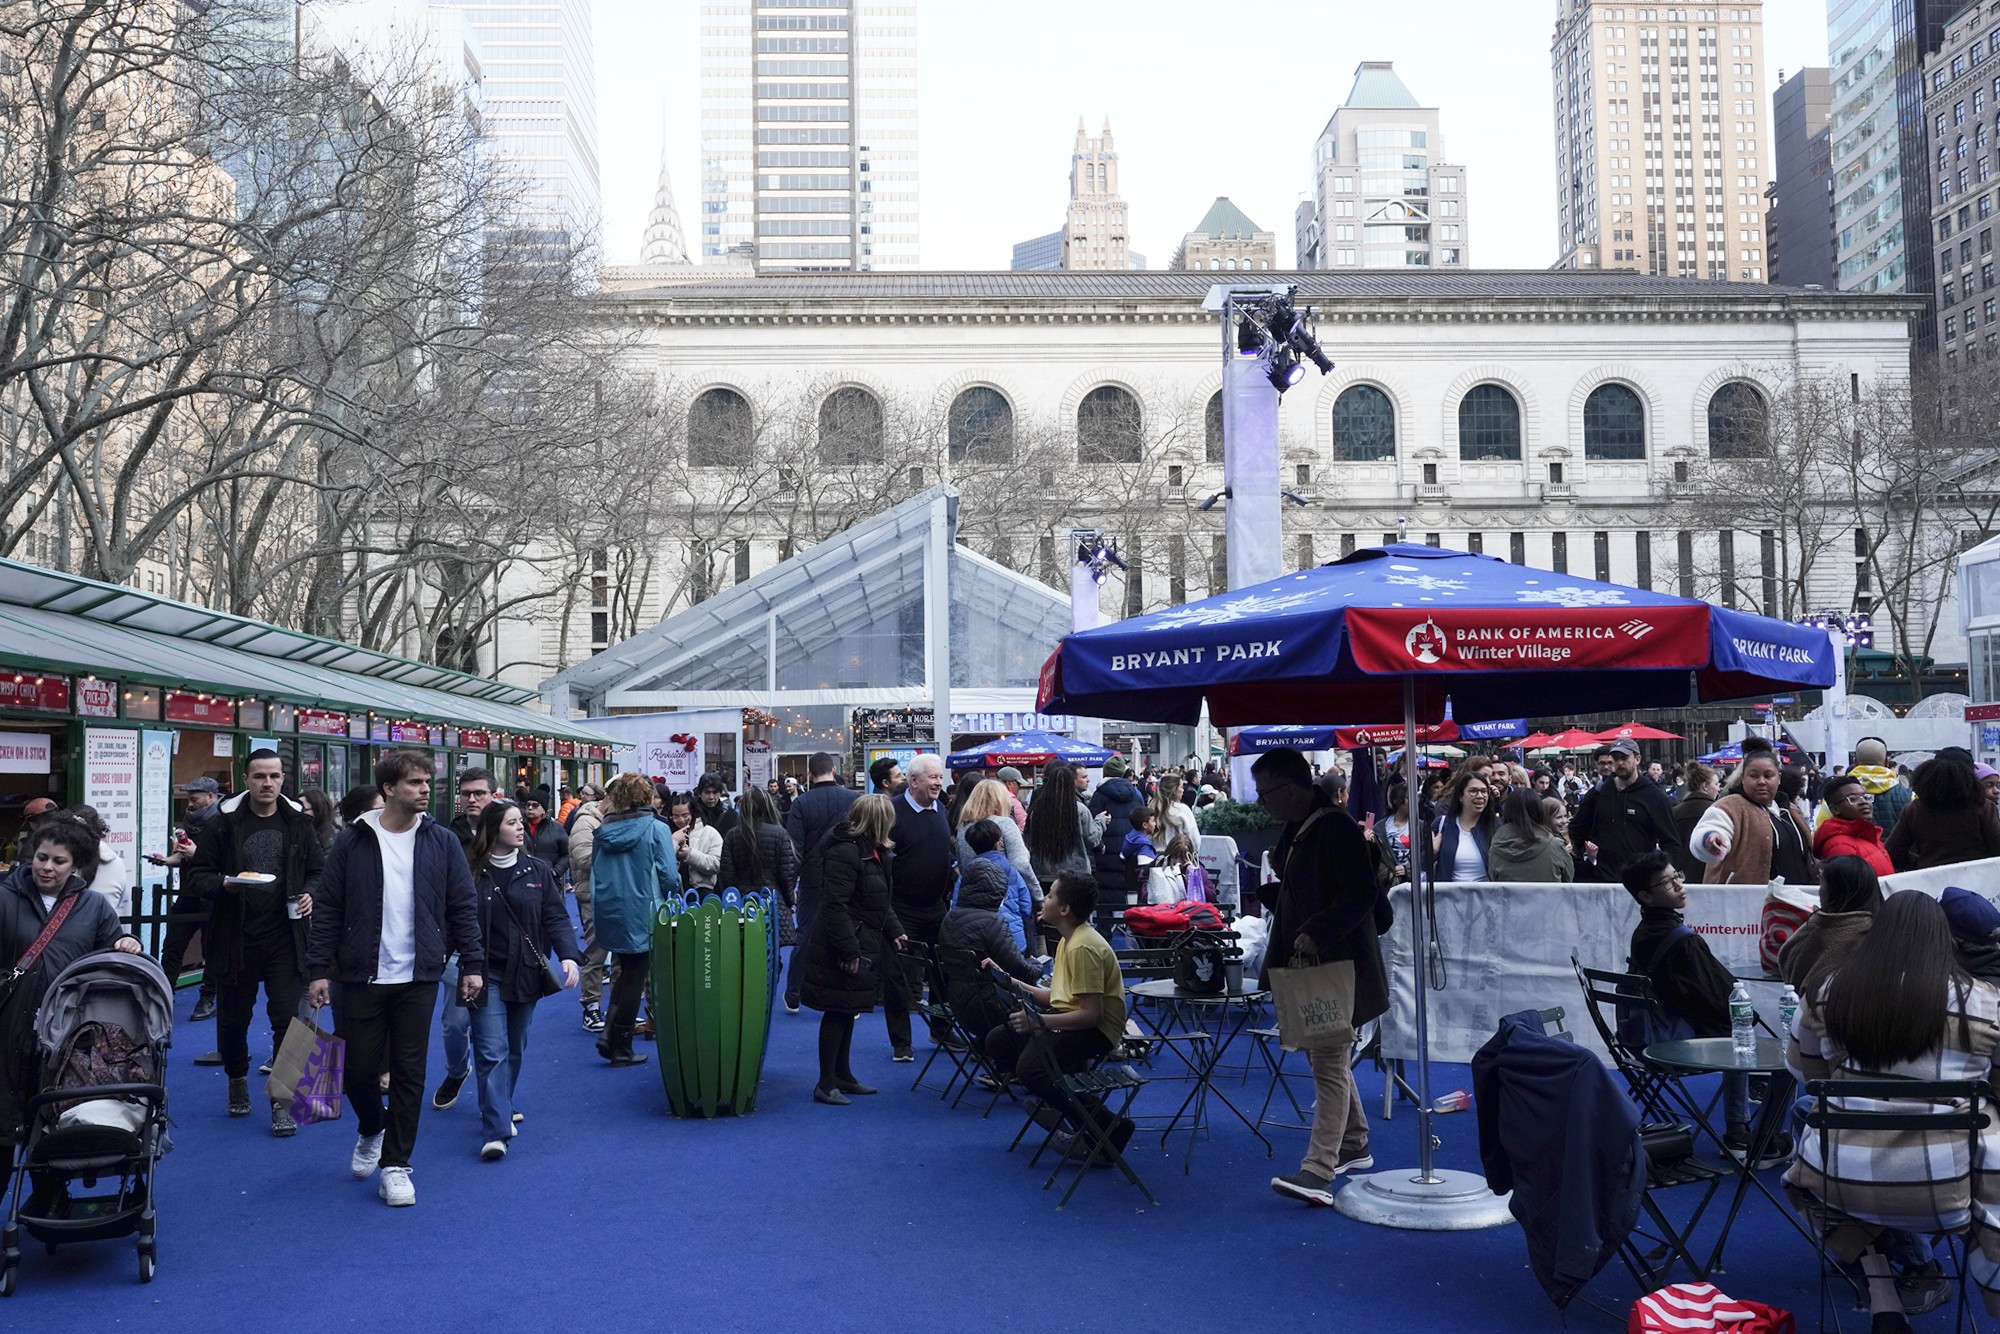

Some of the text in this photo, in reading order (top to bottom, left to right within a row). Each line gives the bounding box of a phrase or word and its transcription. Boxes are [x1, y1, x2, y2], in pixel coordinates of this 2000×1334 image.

[1456, 627, 1615, 640] BANK OF AMERICA
[1111, 640, 1283, 671] BRYANT PARK
[1457, 643, 1571, 661] Winter Village
[1732, 637, 1815, 664] BRYANT PARK
[20, 684, 37, 699] CHICK
[86, 691, 107, 705] PICK-UP
[966, 713, 1074, 731] THE LODGE
[1255, 738, 1290, 746] BRYANT
[30, 747, 47, 761] STICK
[648, 748, 686, 761] Rinkside
[746, 746, 768, 754] Stout
[875, 751, 917, 760] BUMPER
[660, 760, 683, 769] BAR
[111, 831, 133, 844] SPECIALS
[1687, 923, 1761, 935] #wintervill
[1300, 999, 1340, 1016] WHOLE
[1305, 1011, 1343, 1027] FOODS
